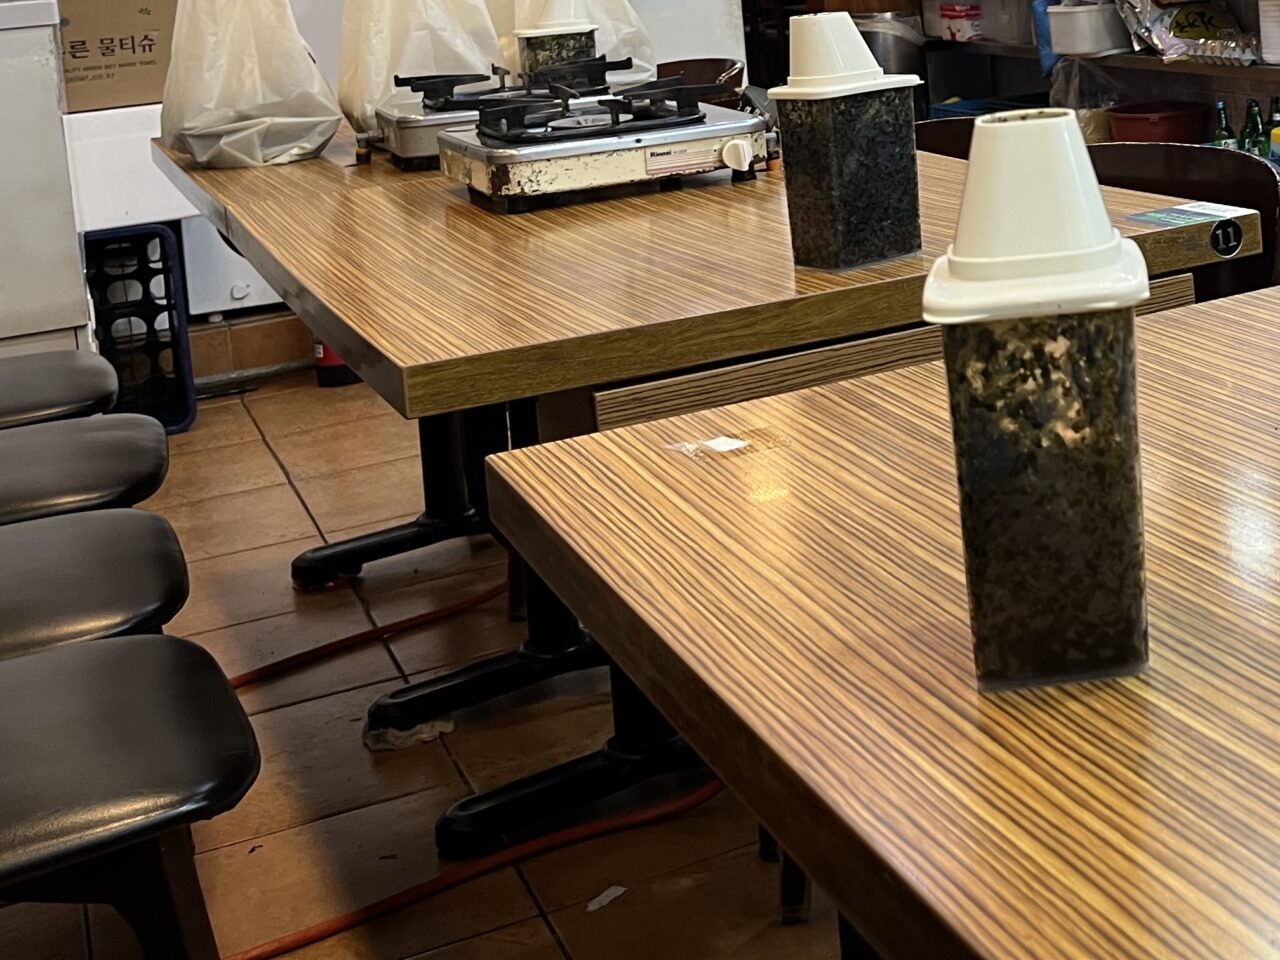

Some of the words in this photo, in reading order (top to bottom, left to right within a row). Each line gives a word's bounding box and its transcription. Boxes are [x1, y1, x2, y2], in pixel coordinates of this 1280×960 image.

[62, 40, 90, 59] 른
[97, 34, 156, 57] 물티슈
[1214, 226, 1238, 250] 11
